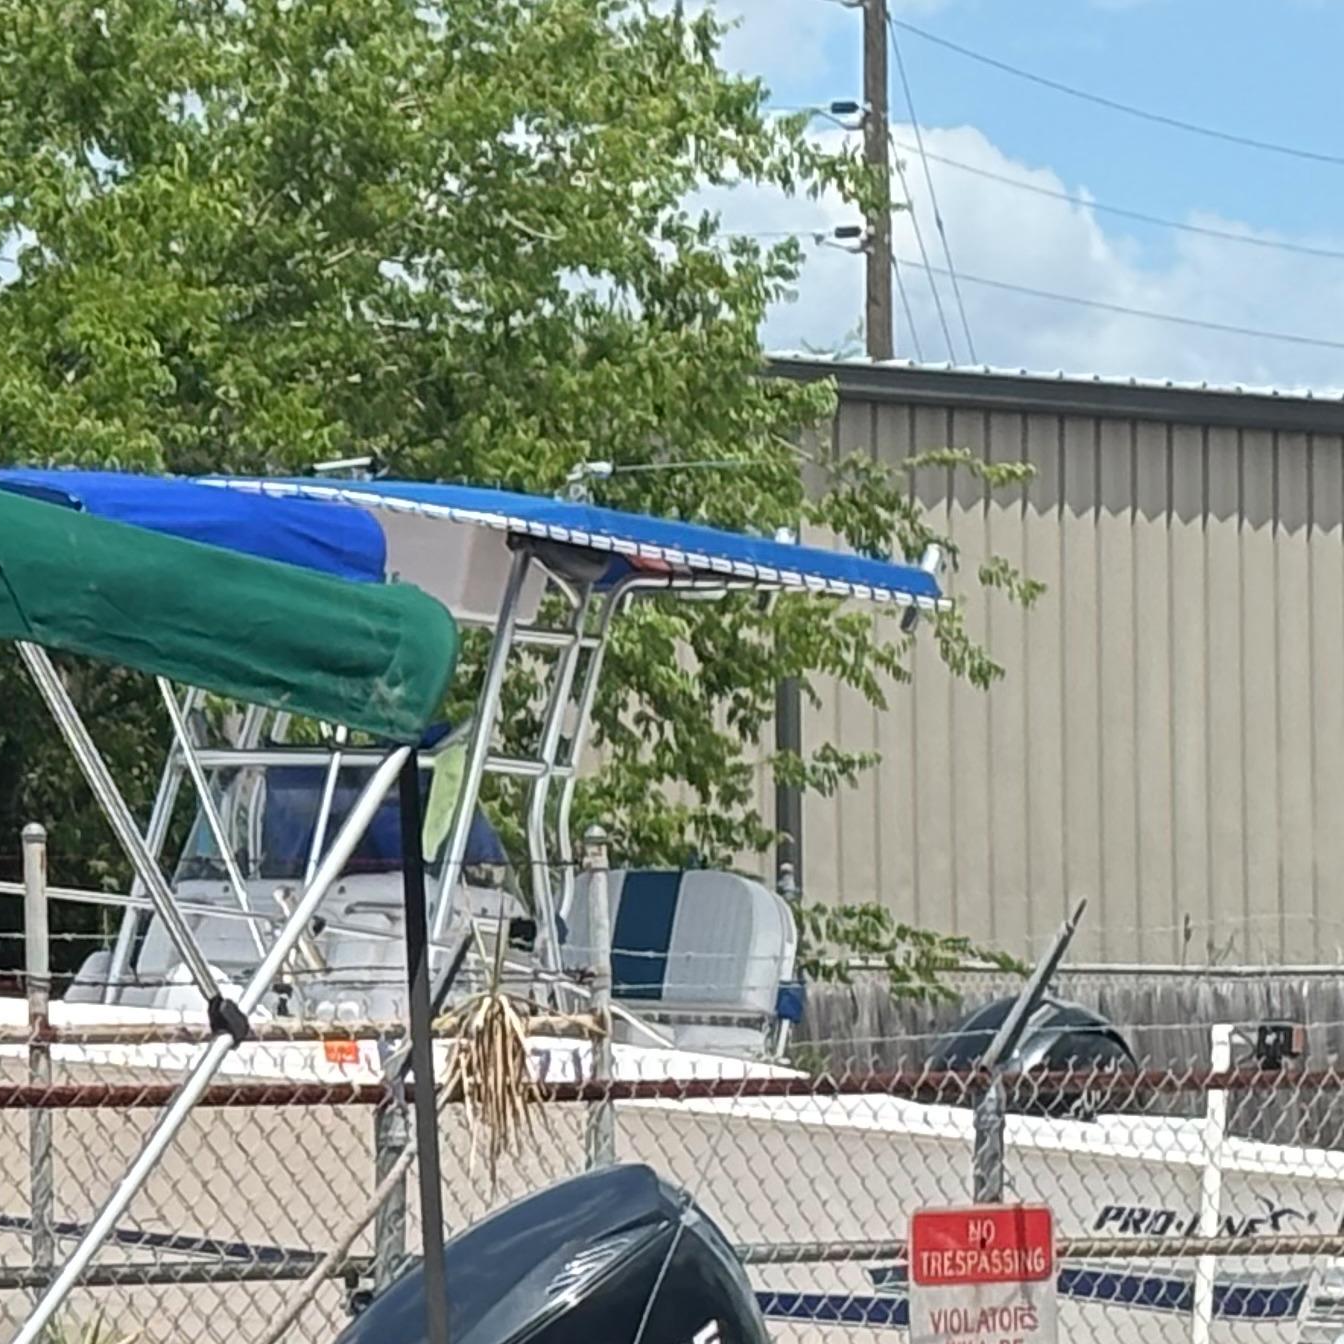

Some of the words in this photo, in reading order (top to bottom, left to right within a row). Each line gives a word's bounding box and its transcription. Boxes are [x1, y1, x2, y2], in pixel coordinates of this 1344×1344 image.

[968, 1219, 996, 1244] NO
[921, 1246, 1046, 1278] TRESPASSING
[929, 1304, 1039, 1334] VIOLATORS
